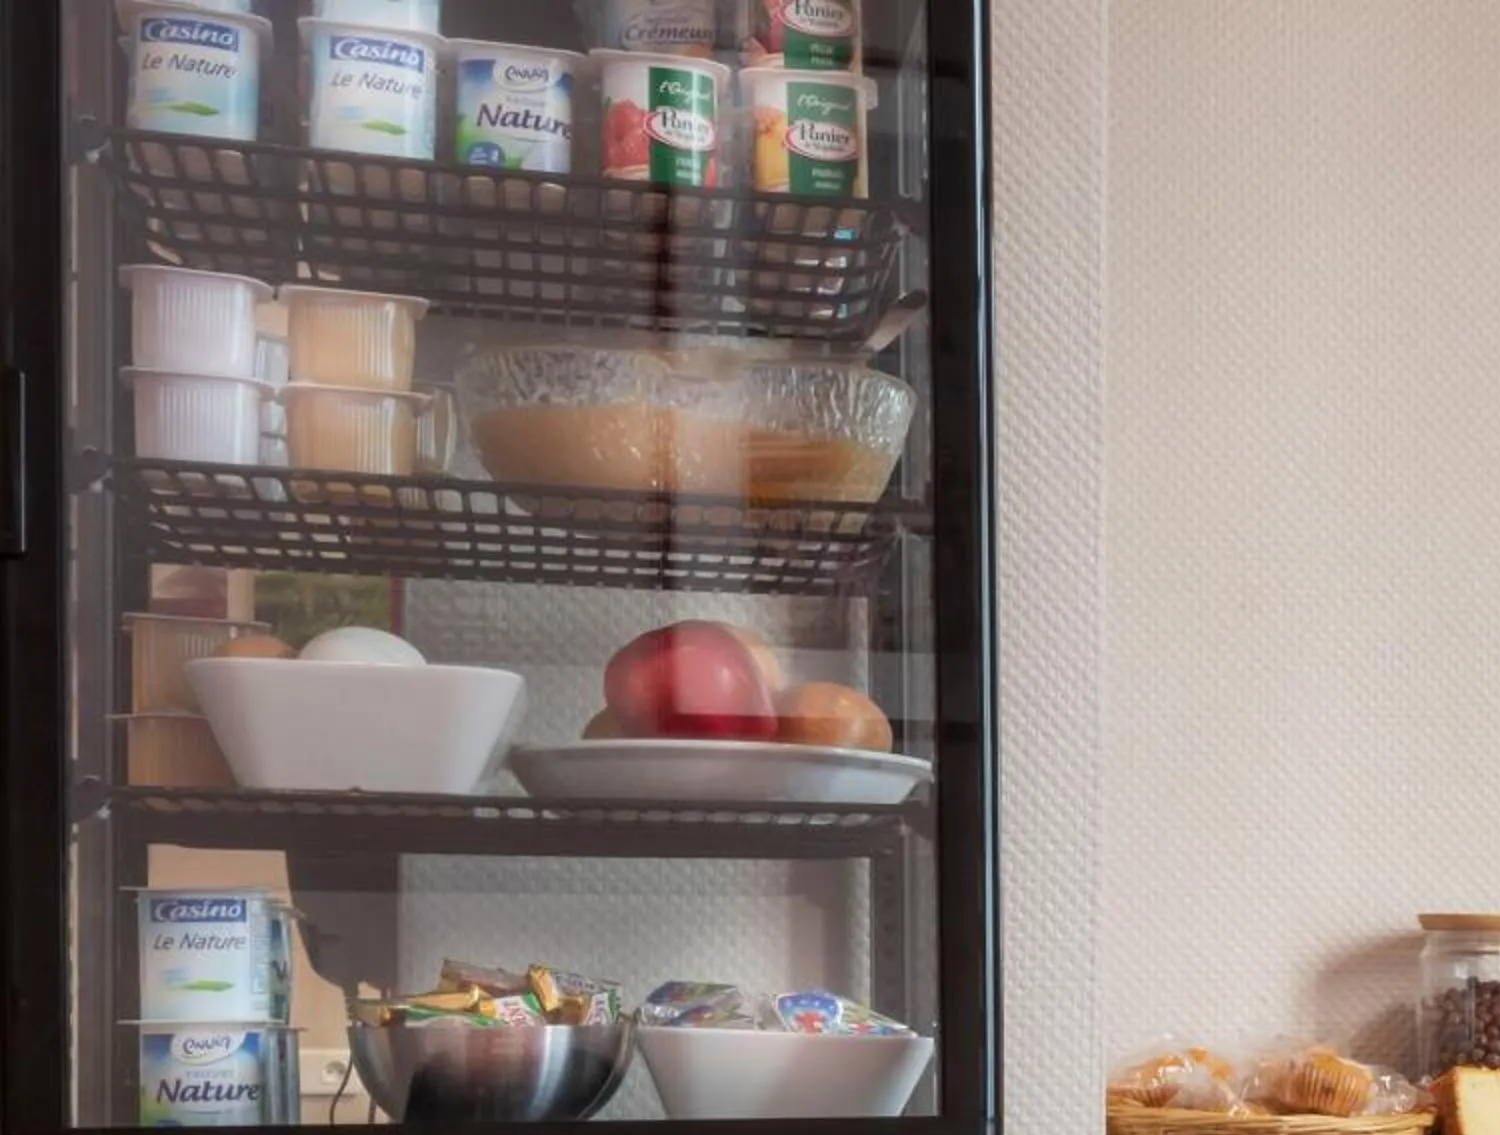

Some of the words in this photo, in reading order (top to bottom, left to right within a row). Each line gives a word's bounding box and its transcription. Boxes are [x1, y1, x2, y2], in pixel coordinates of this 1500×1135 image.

[145, 20, 234, 45] Casino
[335, 39, 420, 65] Casino
[141, 53, 163, 71] Le
[167, 54, 238, 78] Nature
[331, 70, 354, 87] Le
[359, 72, 423, 98] Nature
[476, 103, 572, 140] Nature
[154, 900, 242, 921] Casino
[153, 933, 174, 950] Le
[179, 931, 247, 951] Nature
[156, 1078, 261, 1104] Nature
